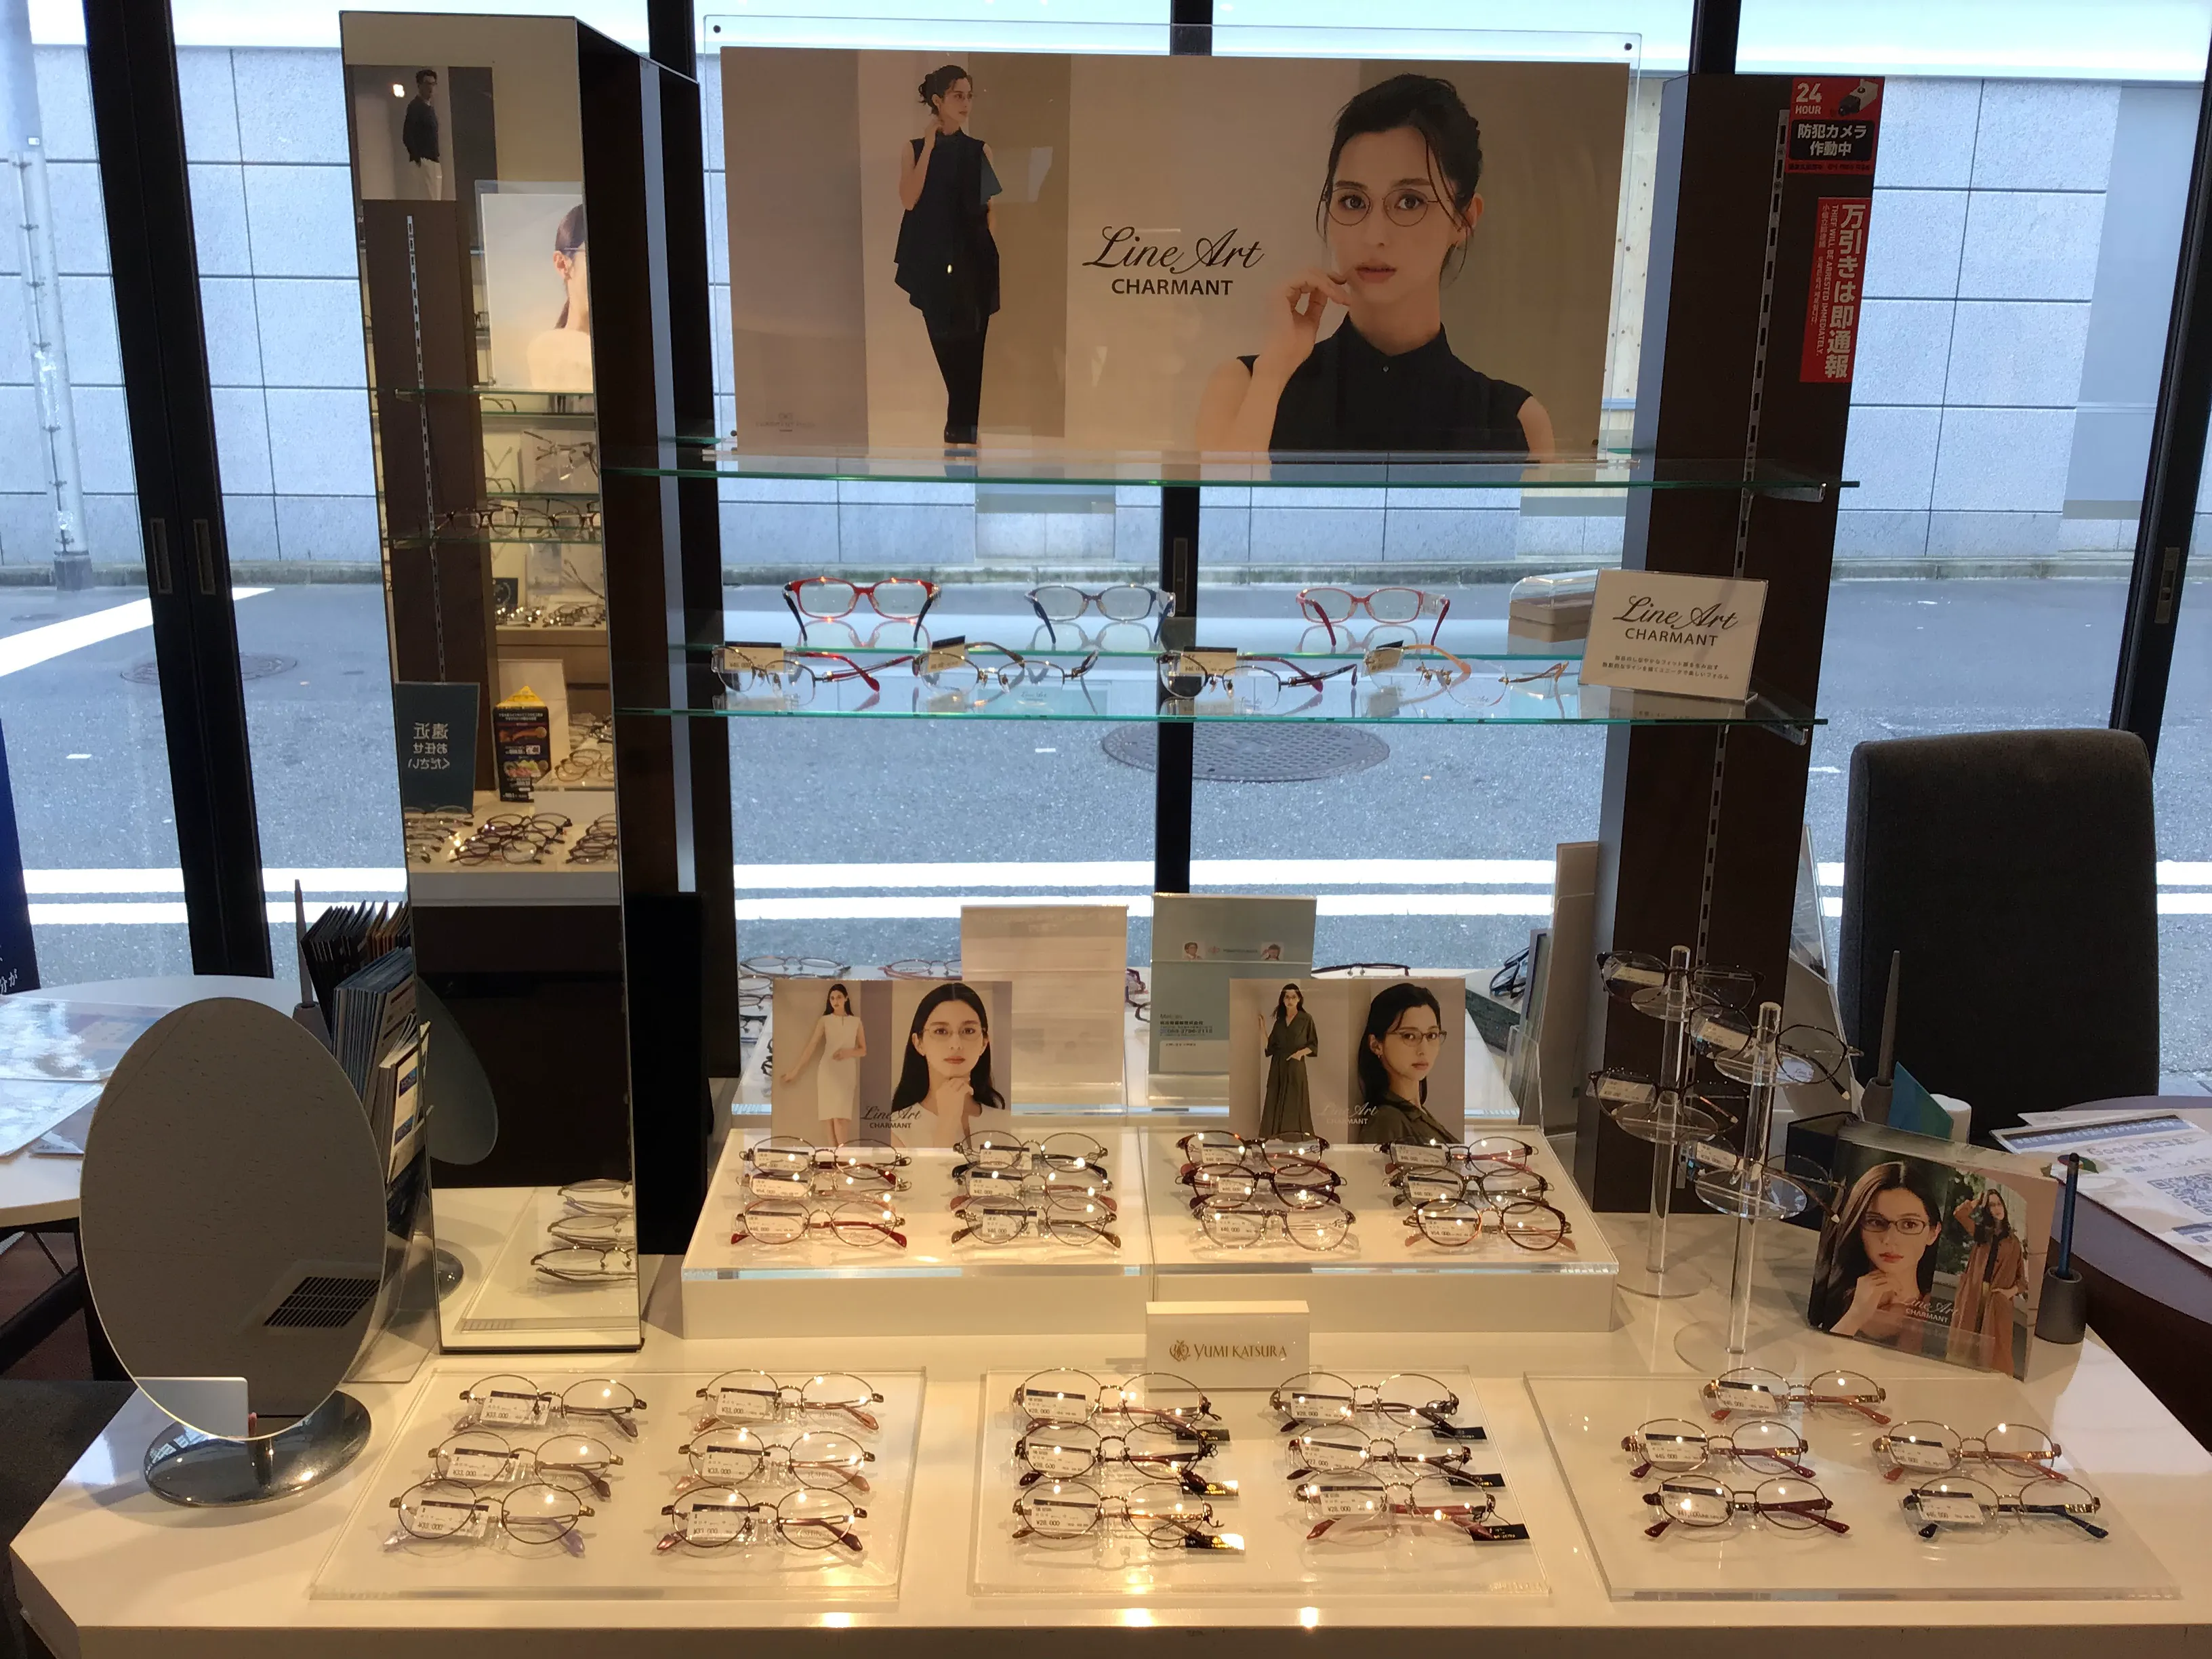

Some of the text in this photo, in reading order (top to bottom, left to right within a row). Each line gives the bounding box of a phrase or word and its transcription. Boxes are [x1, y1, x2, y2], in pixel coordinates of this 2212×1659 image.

[1796, 82, 1822, 103] 24
[1795, 105, 1822, 115] HOUR
[1797, 123, 1868, 139] 防犯カメラ
[1810, 141, 1852, 157] 作動中
[1829, 205, 1839, 226] THIEF
[1827, 229, 1837, 248] WILL
[1082, 226, 1265, 274] Line Art
[1826, 249, 1834, 260] BE
[1111, 279, 1233, 295] CHARMANT
[1822, 261, 1833, 301] ARRESTED
[1824, 204, 1866, 378] 万引きは即通報
[1612, 595, 1739, 630] Line Art
[1625, 628, 1719, 647] CHARMANT
[889, 1106, 922, 1122] Art
[1348, 1101, 1378, 1118] Art
[1905, 1307, 1949, 1323] CHARMANT
[1193, 1343, 1288, 1361] YUMI KATSURA
